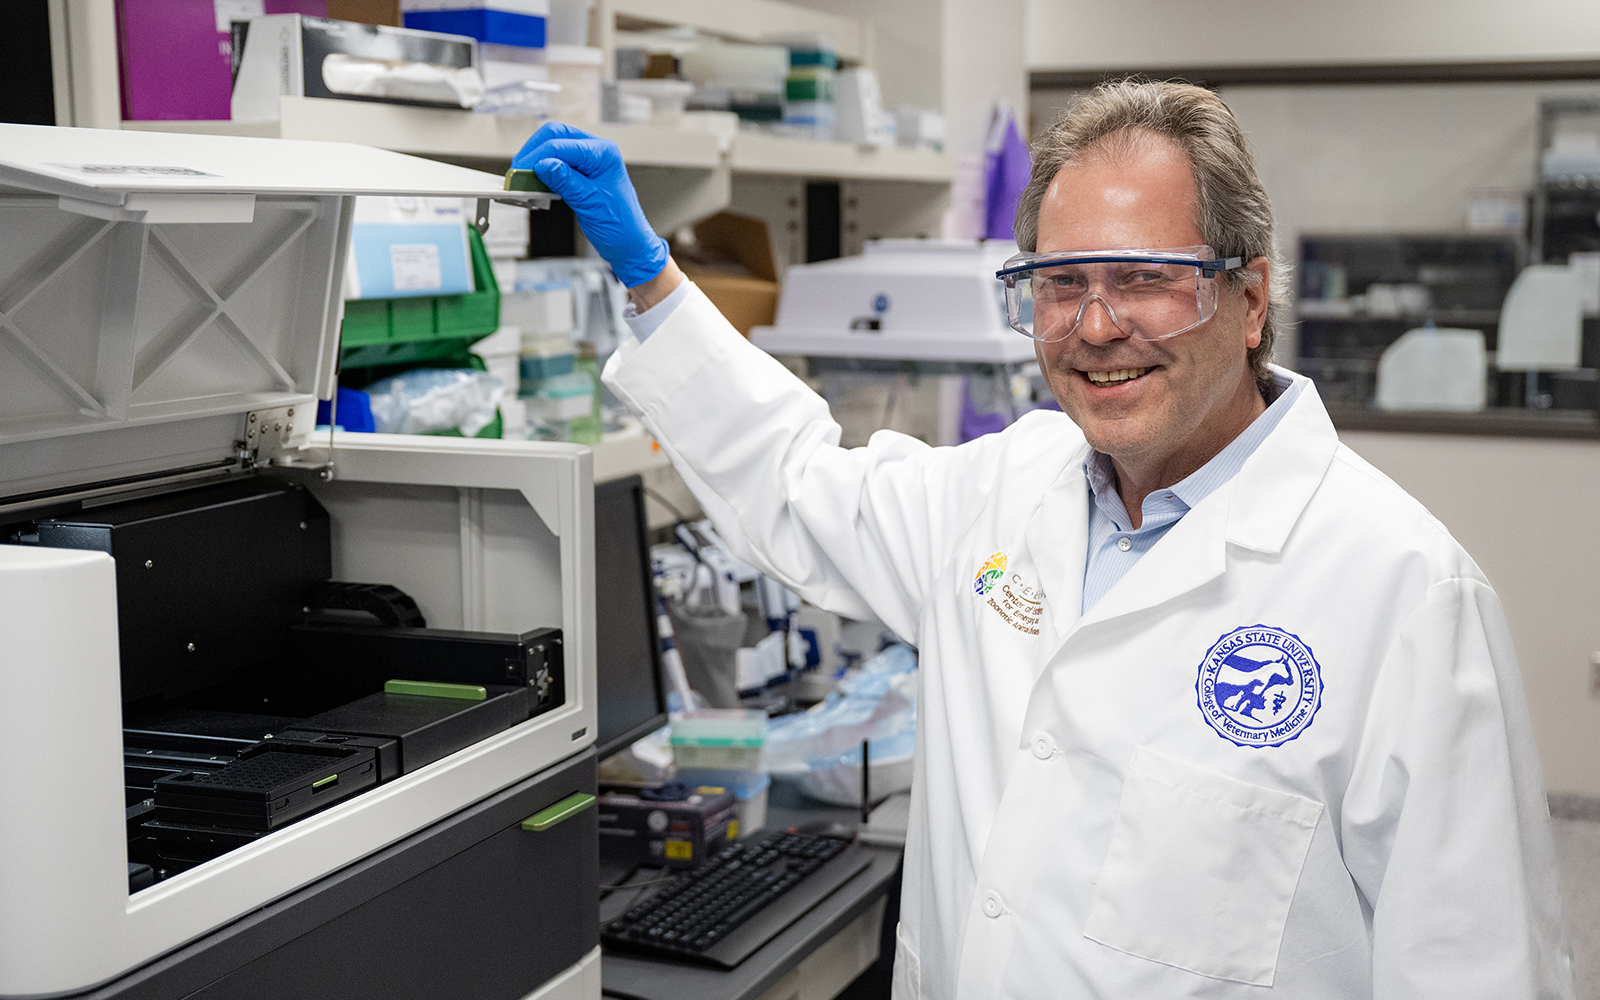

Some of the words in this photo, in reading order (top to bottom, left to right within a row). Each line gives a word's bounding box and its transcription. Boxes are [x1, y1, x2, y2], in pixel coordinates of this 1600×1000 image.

[1002, 584, 1025, 609] Center
[1002, 599, 1014, 611] for
[986, 597, 1014, 625] Zoonotic
[1206, 635, 1244, 675] KANSAS
[1245, 632, 1282, 646] STATE
[1281, 638, 1315, 705] UNIVERSITY
[1203, 678, 1215, 711] College
[1211, 709, 1225, 721] of
[1222, 716, 1269, 742] Veterinary
[1269, 707, 1308, 739] Medicine
